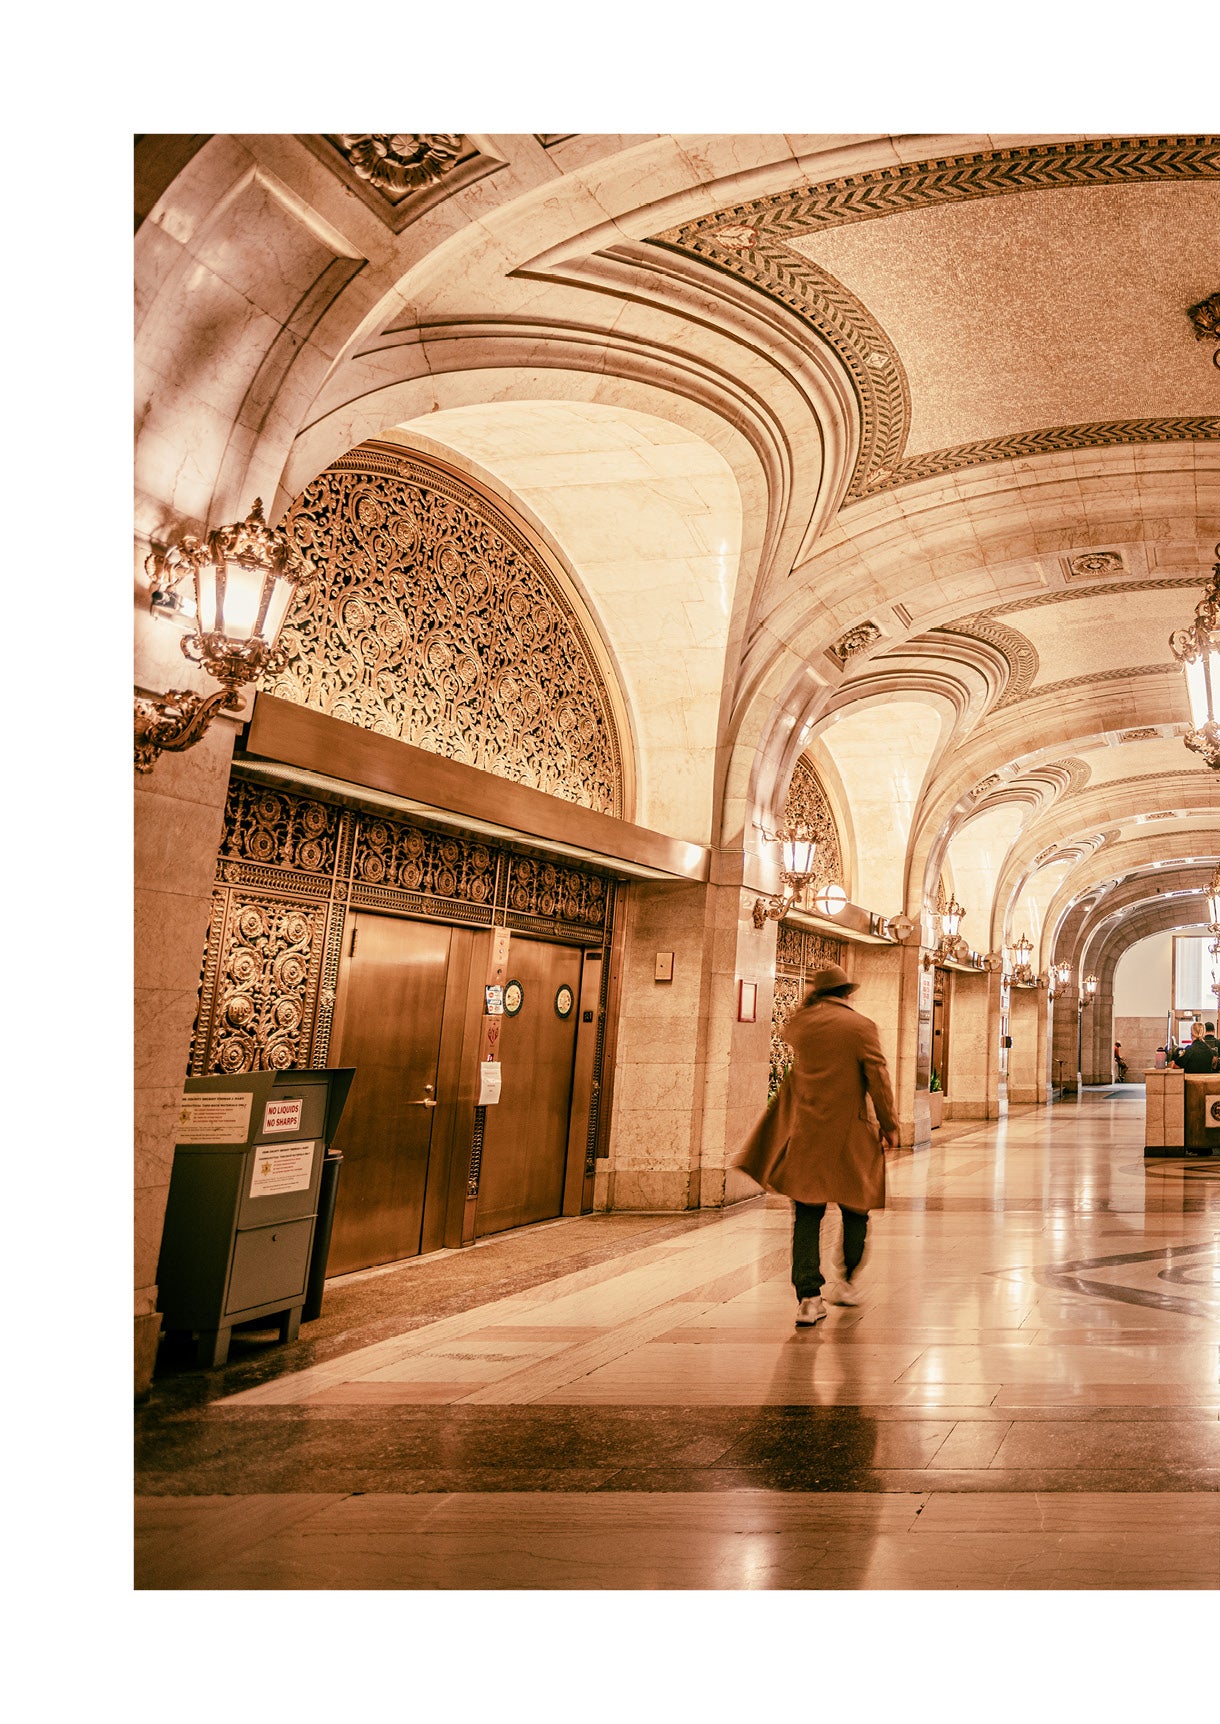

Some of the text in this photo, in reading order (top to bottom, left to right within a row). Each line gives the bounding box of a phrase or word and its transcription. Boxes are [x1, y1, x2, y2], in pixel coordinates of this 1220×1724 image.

[277, 1105, 298, 1114] LIQUIDS
[267, 1117, 297, 1127] NO SHARPS
